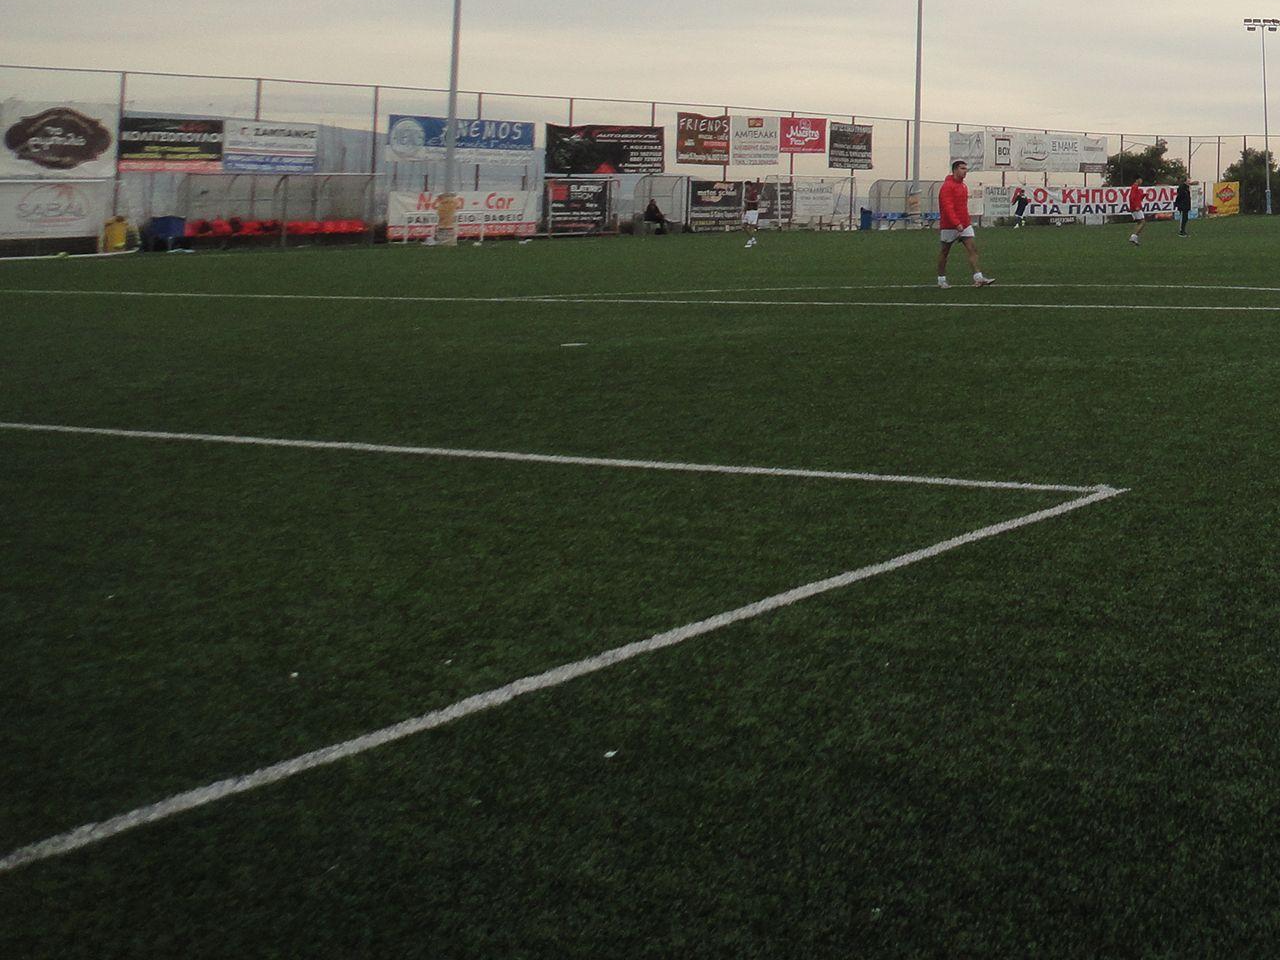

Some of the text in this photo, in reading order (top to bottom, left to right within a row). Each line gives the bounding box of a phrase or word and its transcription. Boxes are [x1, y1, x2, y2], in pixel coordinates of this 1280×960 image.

[679, 117, 729, 133] FRIENDS
[997, 146, 1010, 156] BOX
[486, 192, 515, 210] Car
[1030, 203, 1062, 214] ΓΙΑ
[1068, 203, 1131, 214] ΠΑΝΤΑ
